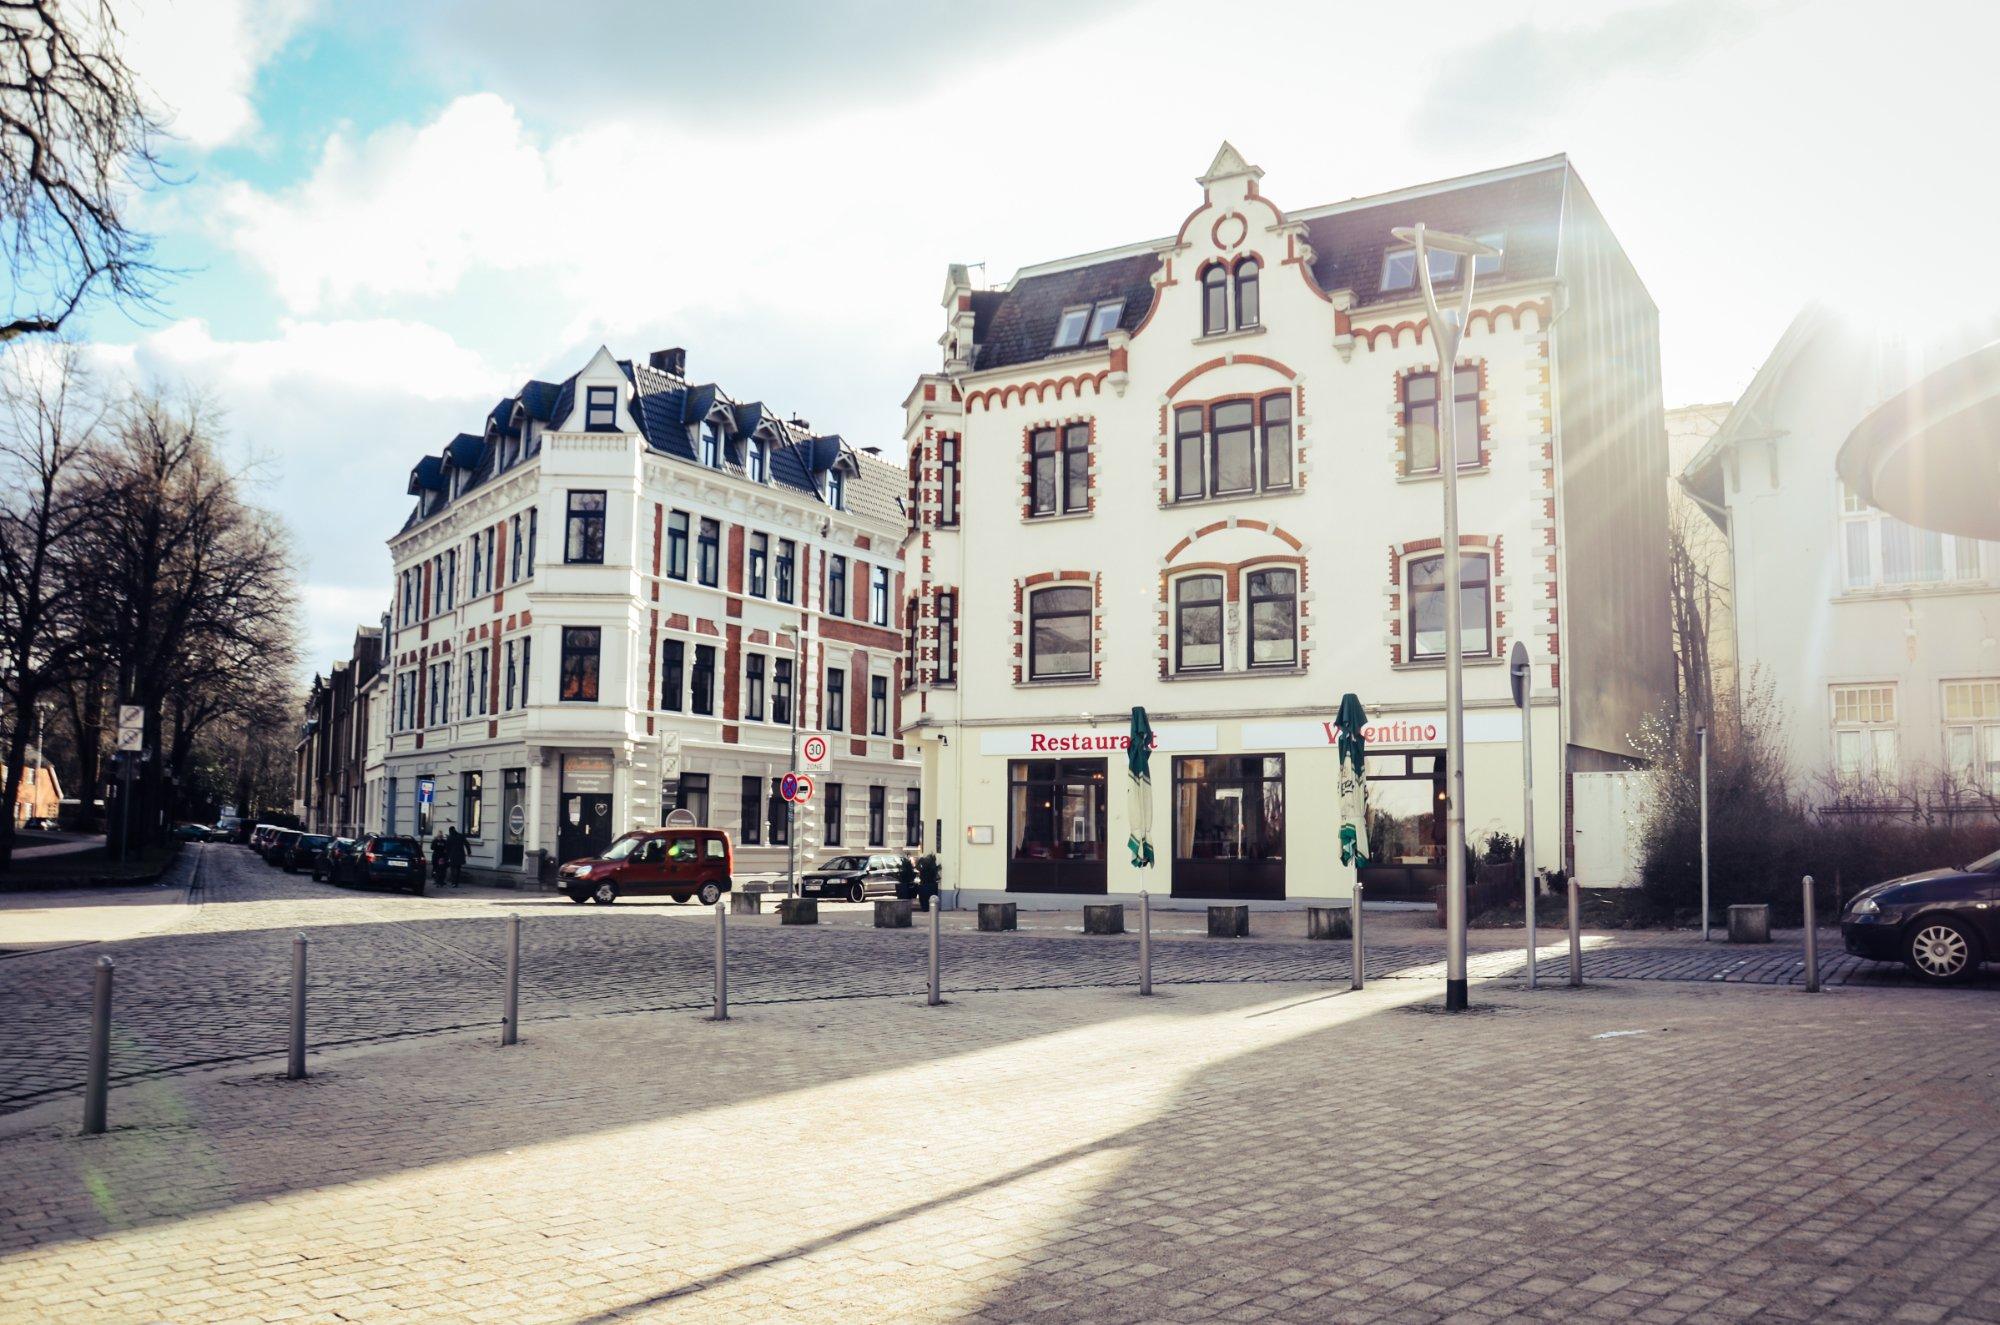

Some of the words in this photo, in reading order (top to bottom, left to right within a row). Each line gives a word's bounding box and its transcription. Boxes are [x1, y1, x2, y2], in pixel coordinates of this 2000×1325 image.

[1030, 731, 1158, 752] Restaurat
[1322, 721, 1437, 744] Ventino
[809, 744, 821, 755] 30
